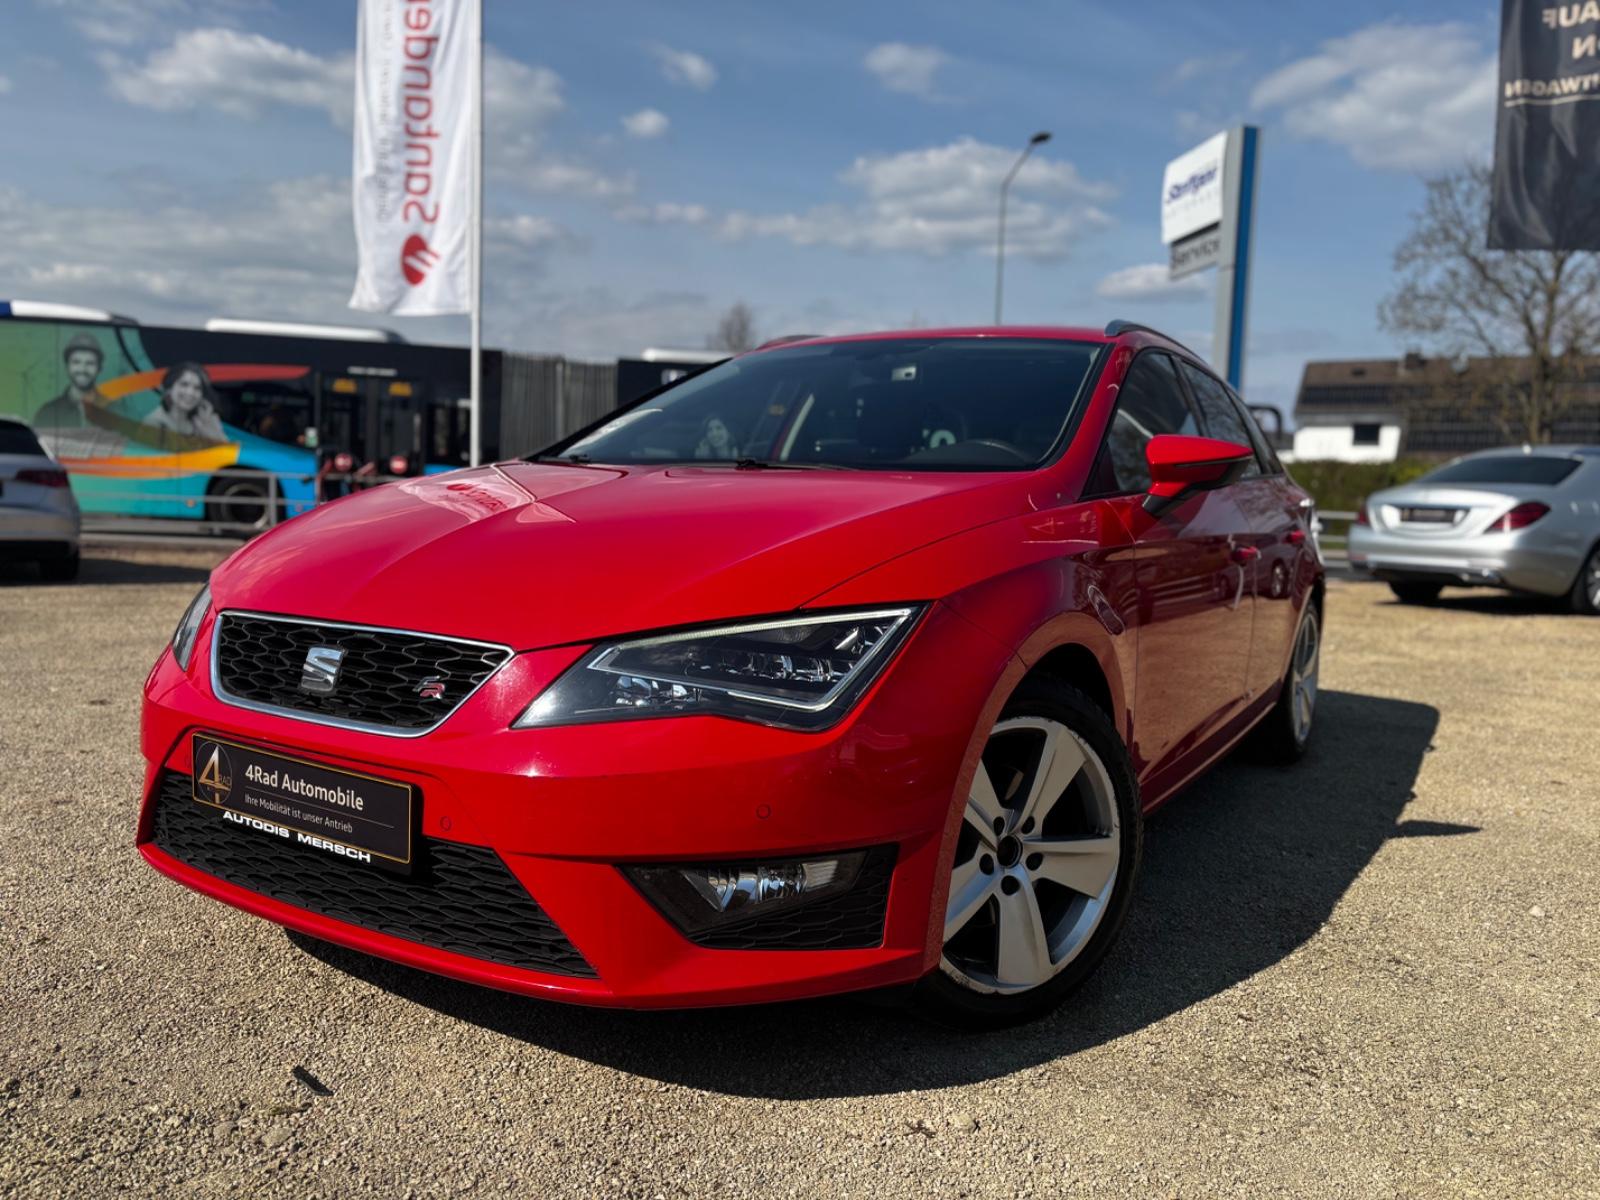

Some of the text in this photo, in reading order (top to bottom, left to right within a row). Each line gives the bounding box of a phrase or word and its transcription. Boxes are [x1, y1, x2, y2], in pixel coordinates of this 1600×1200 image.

[245, 764, 364, 811] 4Rad Automobile
[244, 792, 259, 806] Ihre
[291, 807, 301, 819] ist
[302, 812, 323, 825] unser
[324, 816, 353, 833] Antrieb
[222, 810, 371, 863] AUTODIS MERSCH
